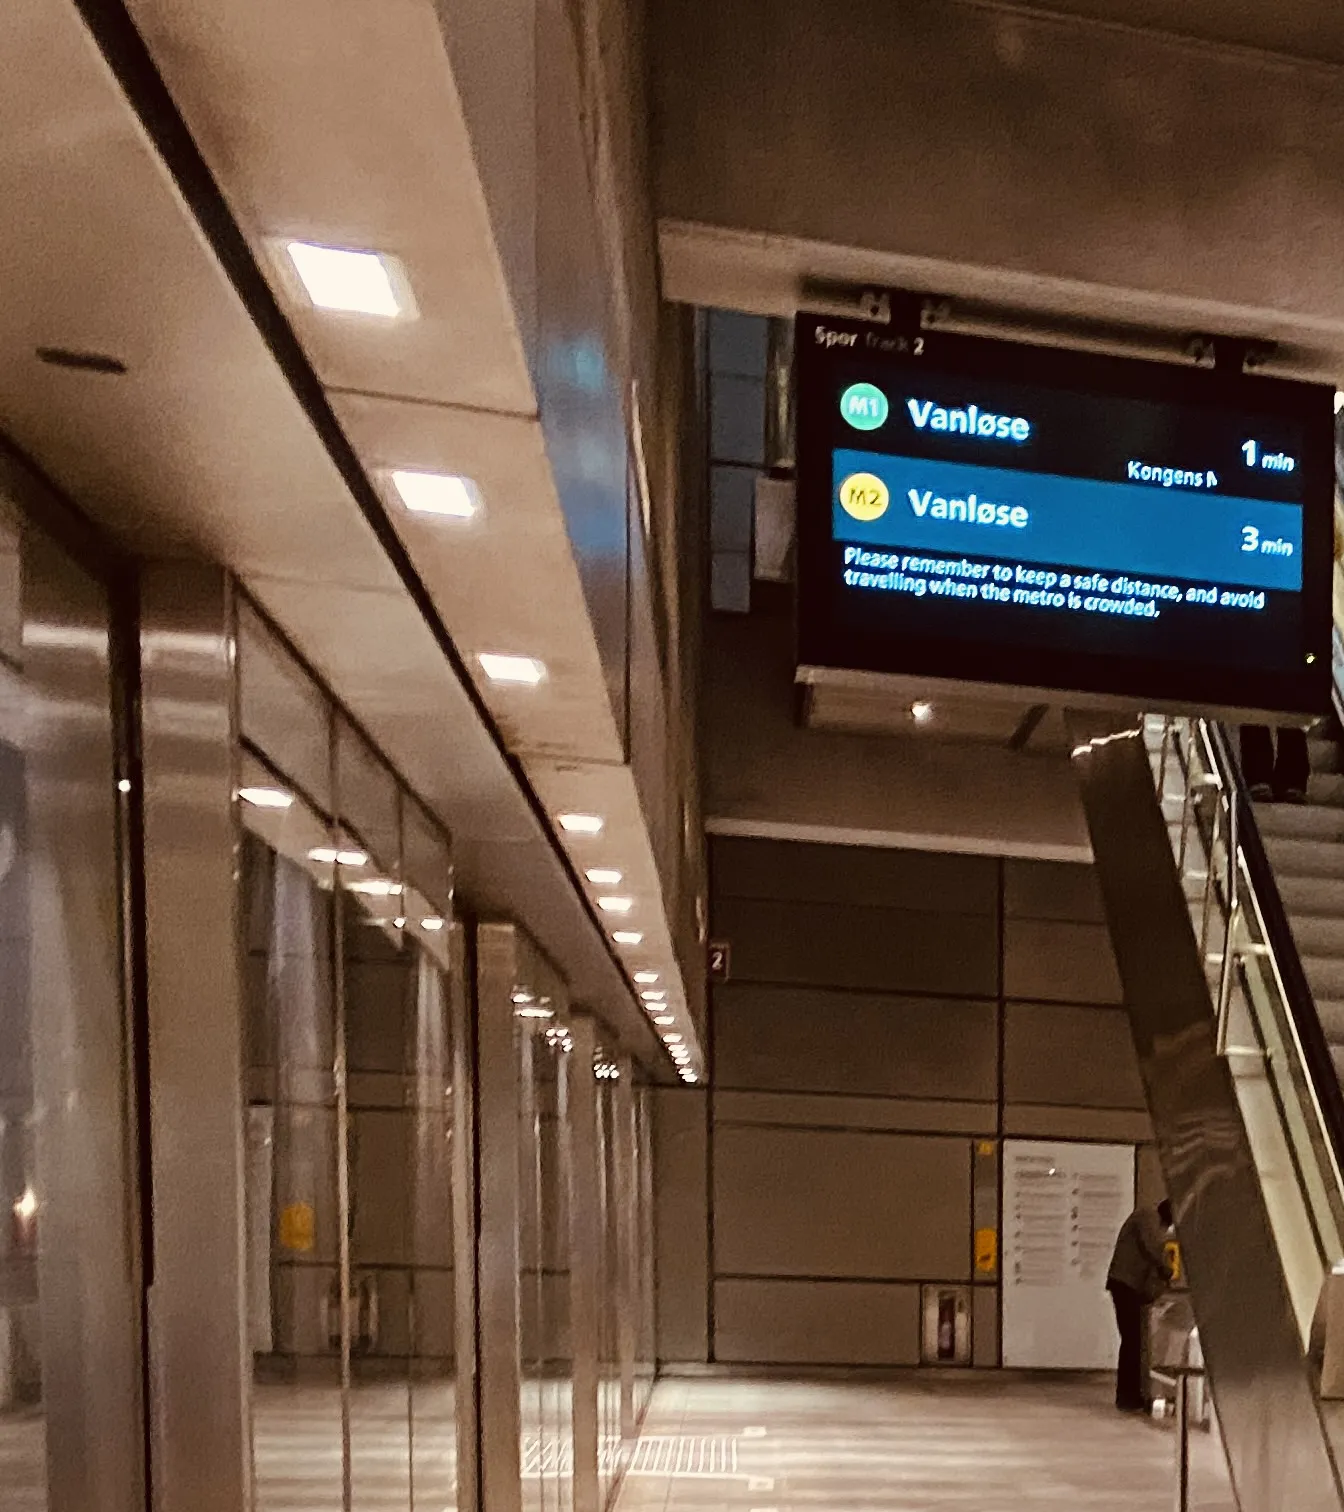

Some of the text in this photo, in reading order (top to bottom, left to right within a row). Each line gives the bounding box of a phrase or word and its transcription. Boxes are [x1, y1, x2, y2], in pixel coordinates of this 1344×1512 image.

[815, 326, 858, 348] Spor
[913, 337, 924, 355] 2
[849, 395, 1030, 441] M1 Vanløse
[1127, 460, 1203, 487] Kongens
[1241, 439, 1295, 472] 1 min
[849, 487, 1029, 528] M2 Vanløse
[1241, 526, 1293, 557] 3 min
[844, 547, 1265, 610] Please remember to keep a safe distance, and avoid
[844, 569, 927, 596] travelling
[928, 578, 978, 598] when
[980, 582, 1010, 601] the
[1013, 588, 1065, 607] metro
[1068, 591, 1082, 609] is
